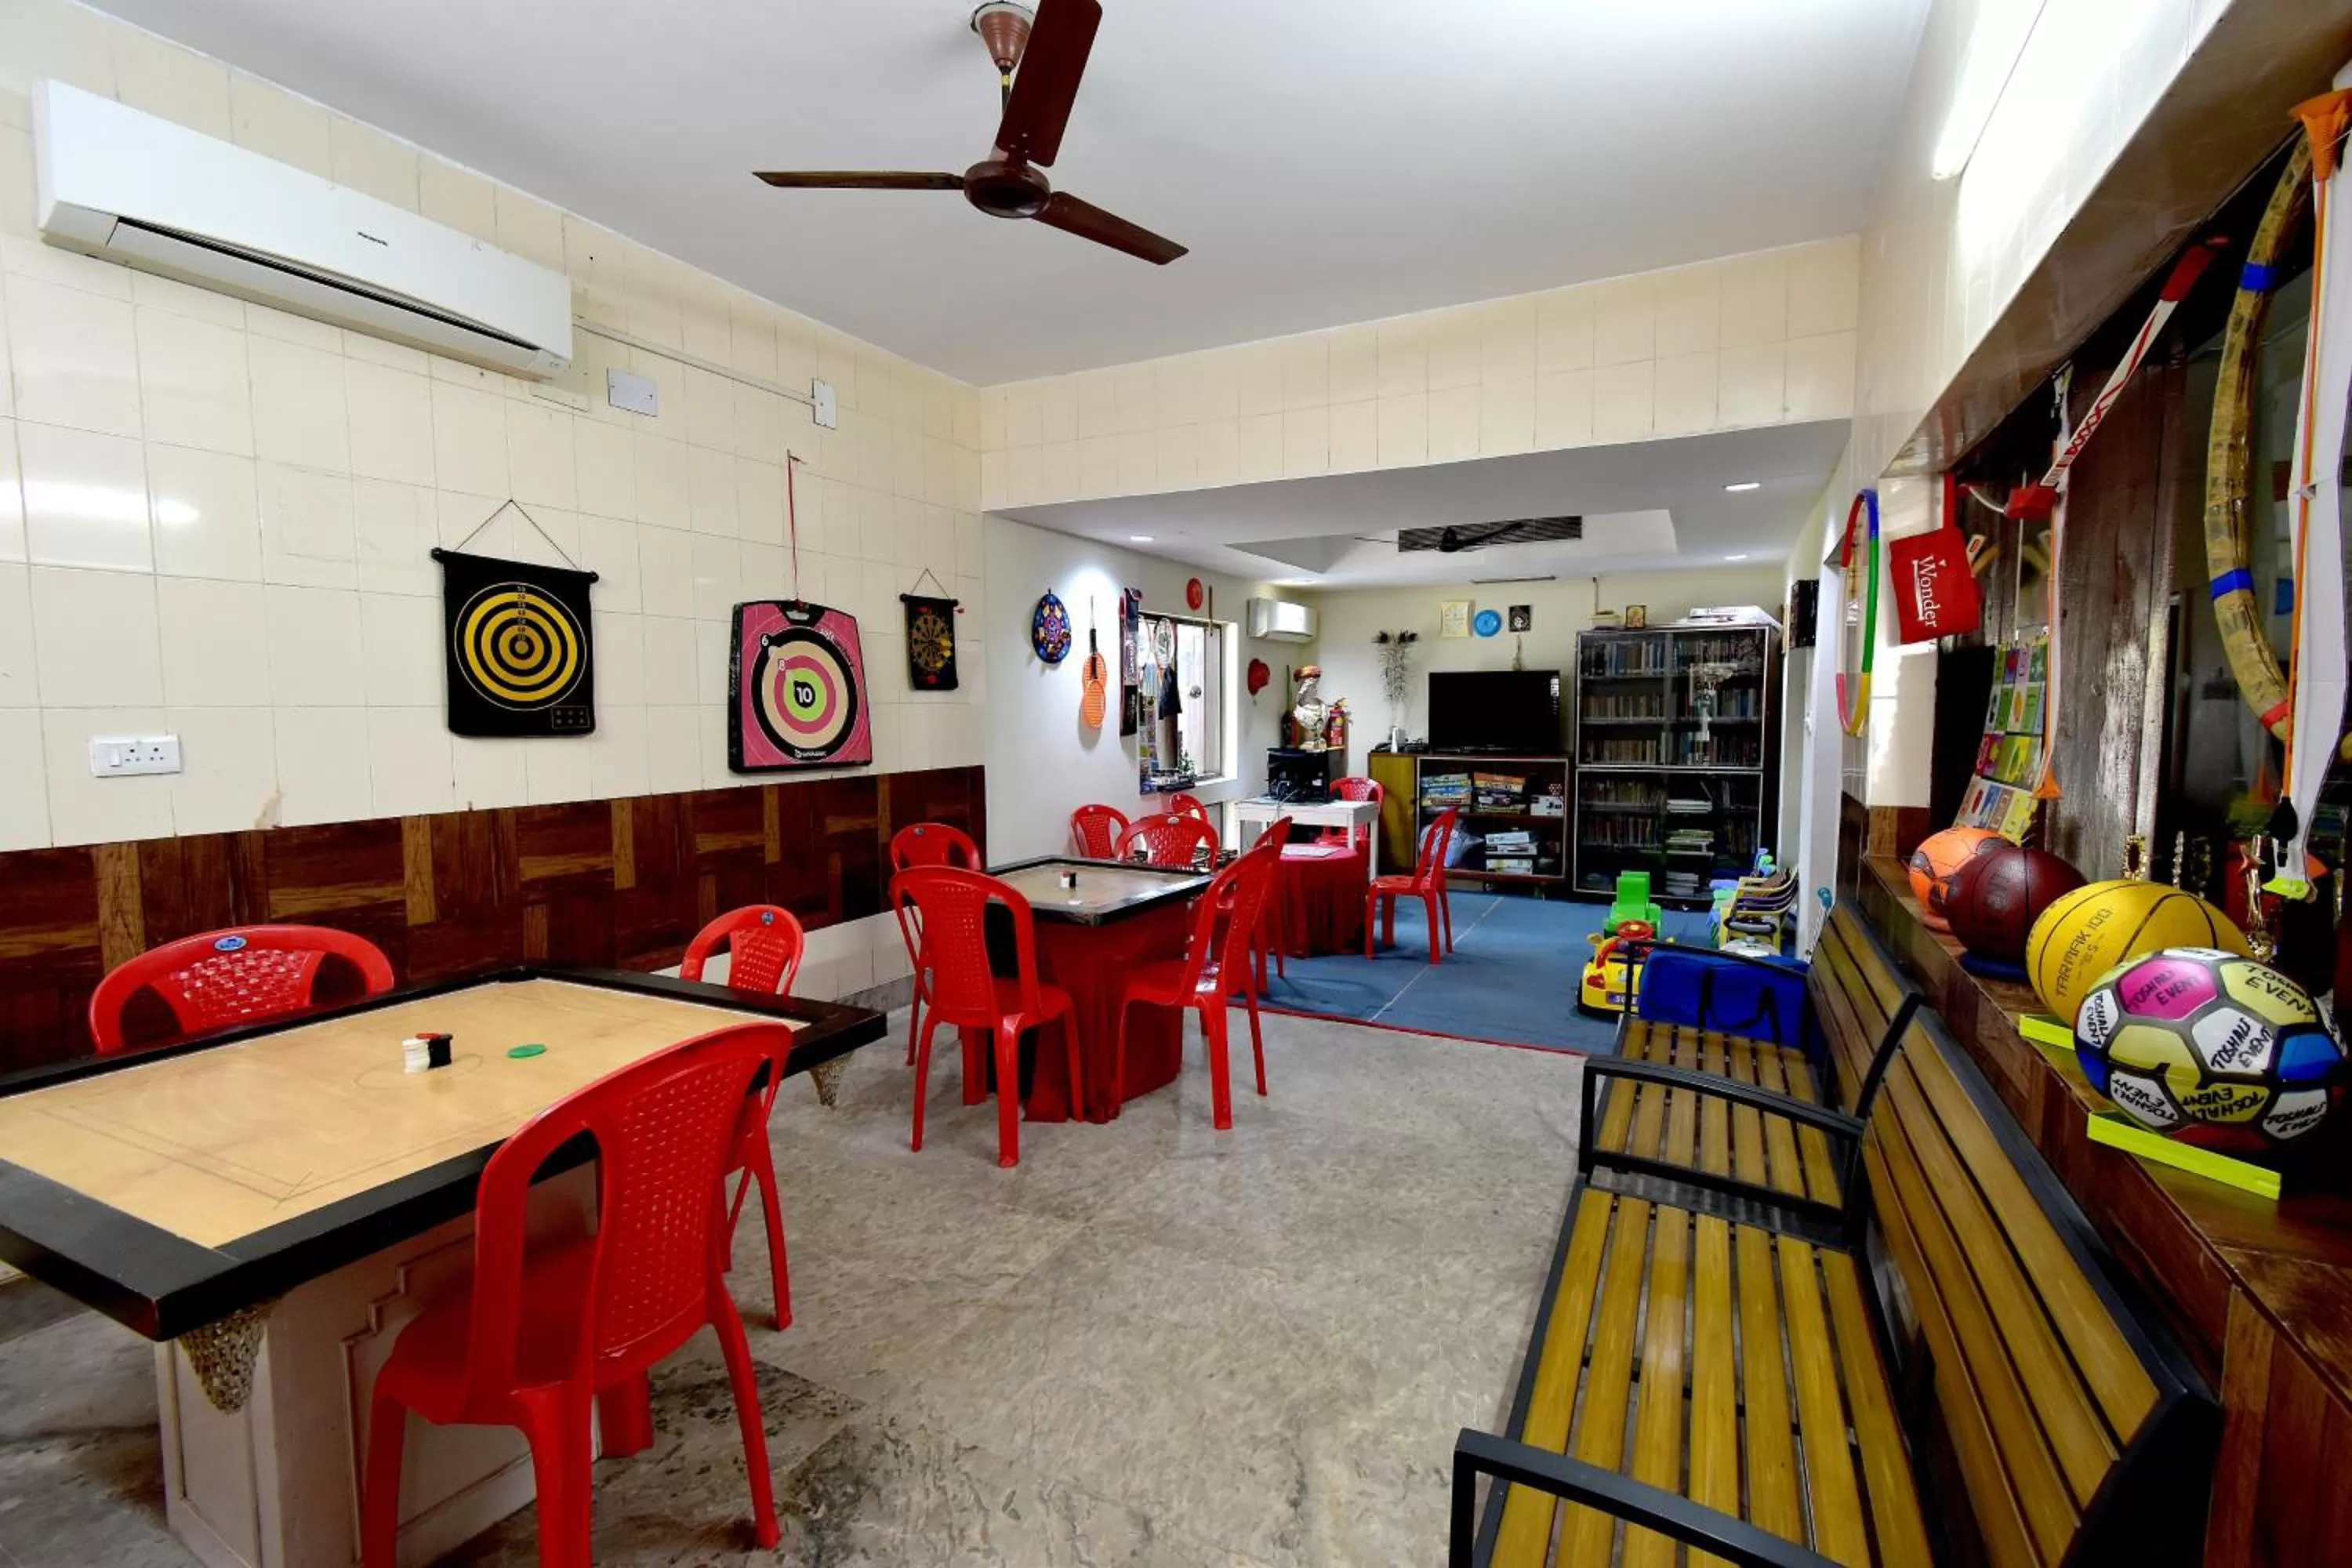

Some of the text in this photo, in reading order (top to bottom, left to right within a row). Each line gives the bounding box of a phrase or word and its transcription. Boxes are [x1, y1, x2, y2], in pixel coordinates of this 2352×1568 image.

[1919, 554, 1940, 627] Wonder
[761, 634, 769, 647] 6
[779, 659, 785, 672] 8
[797, 687, 812, 703] 10
[2056, 929, 2092, 997] TARMAK
[2238, 1025, 2273, 1068] EVENT
